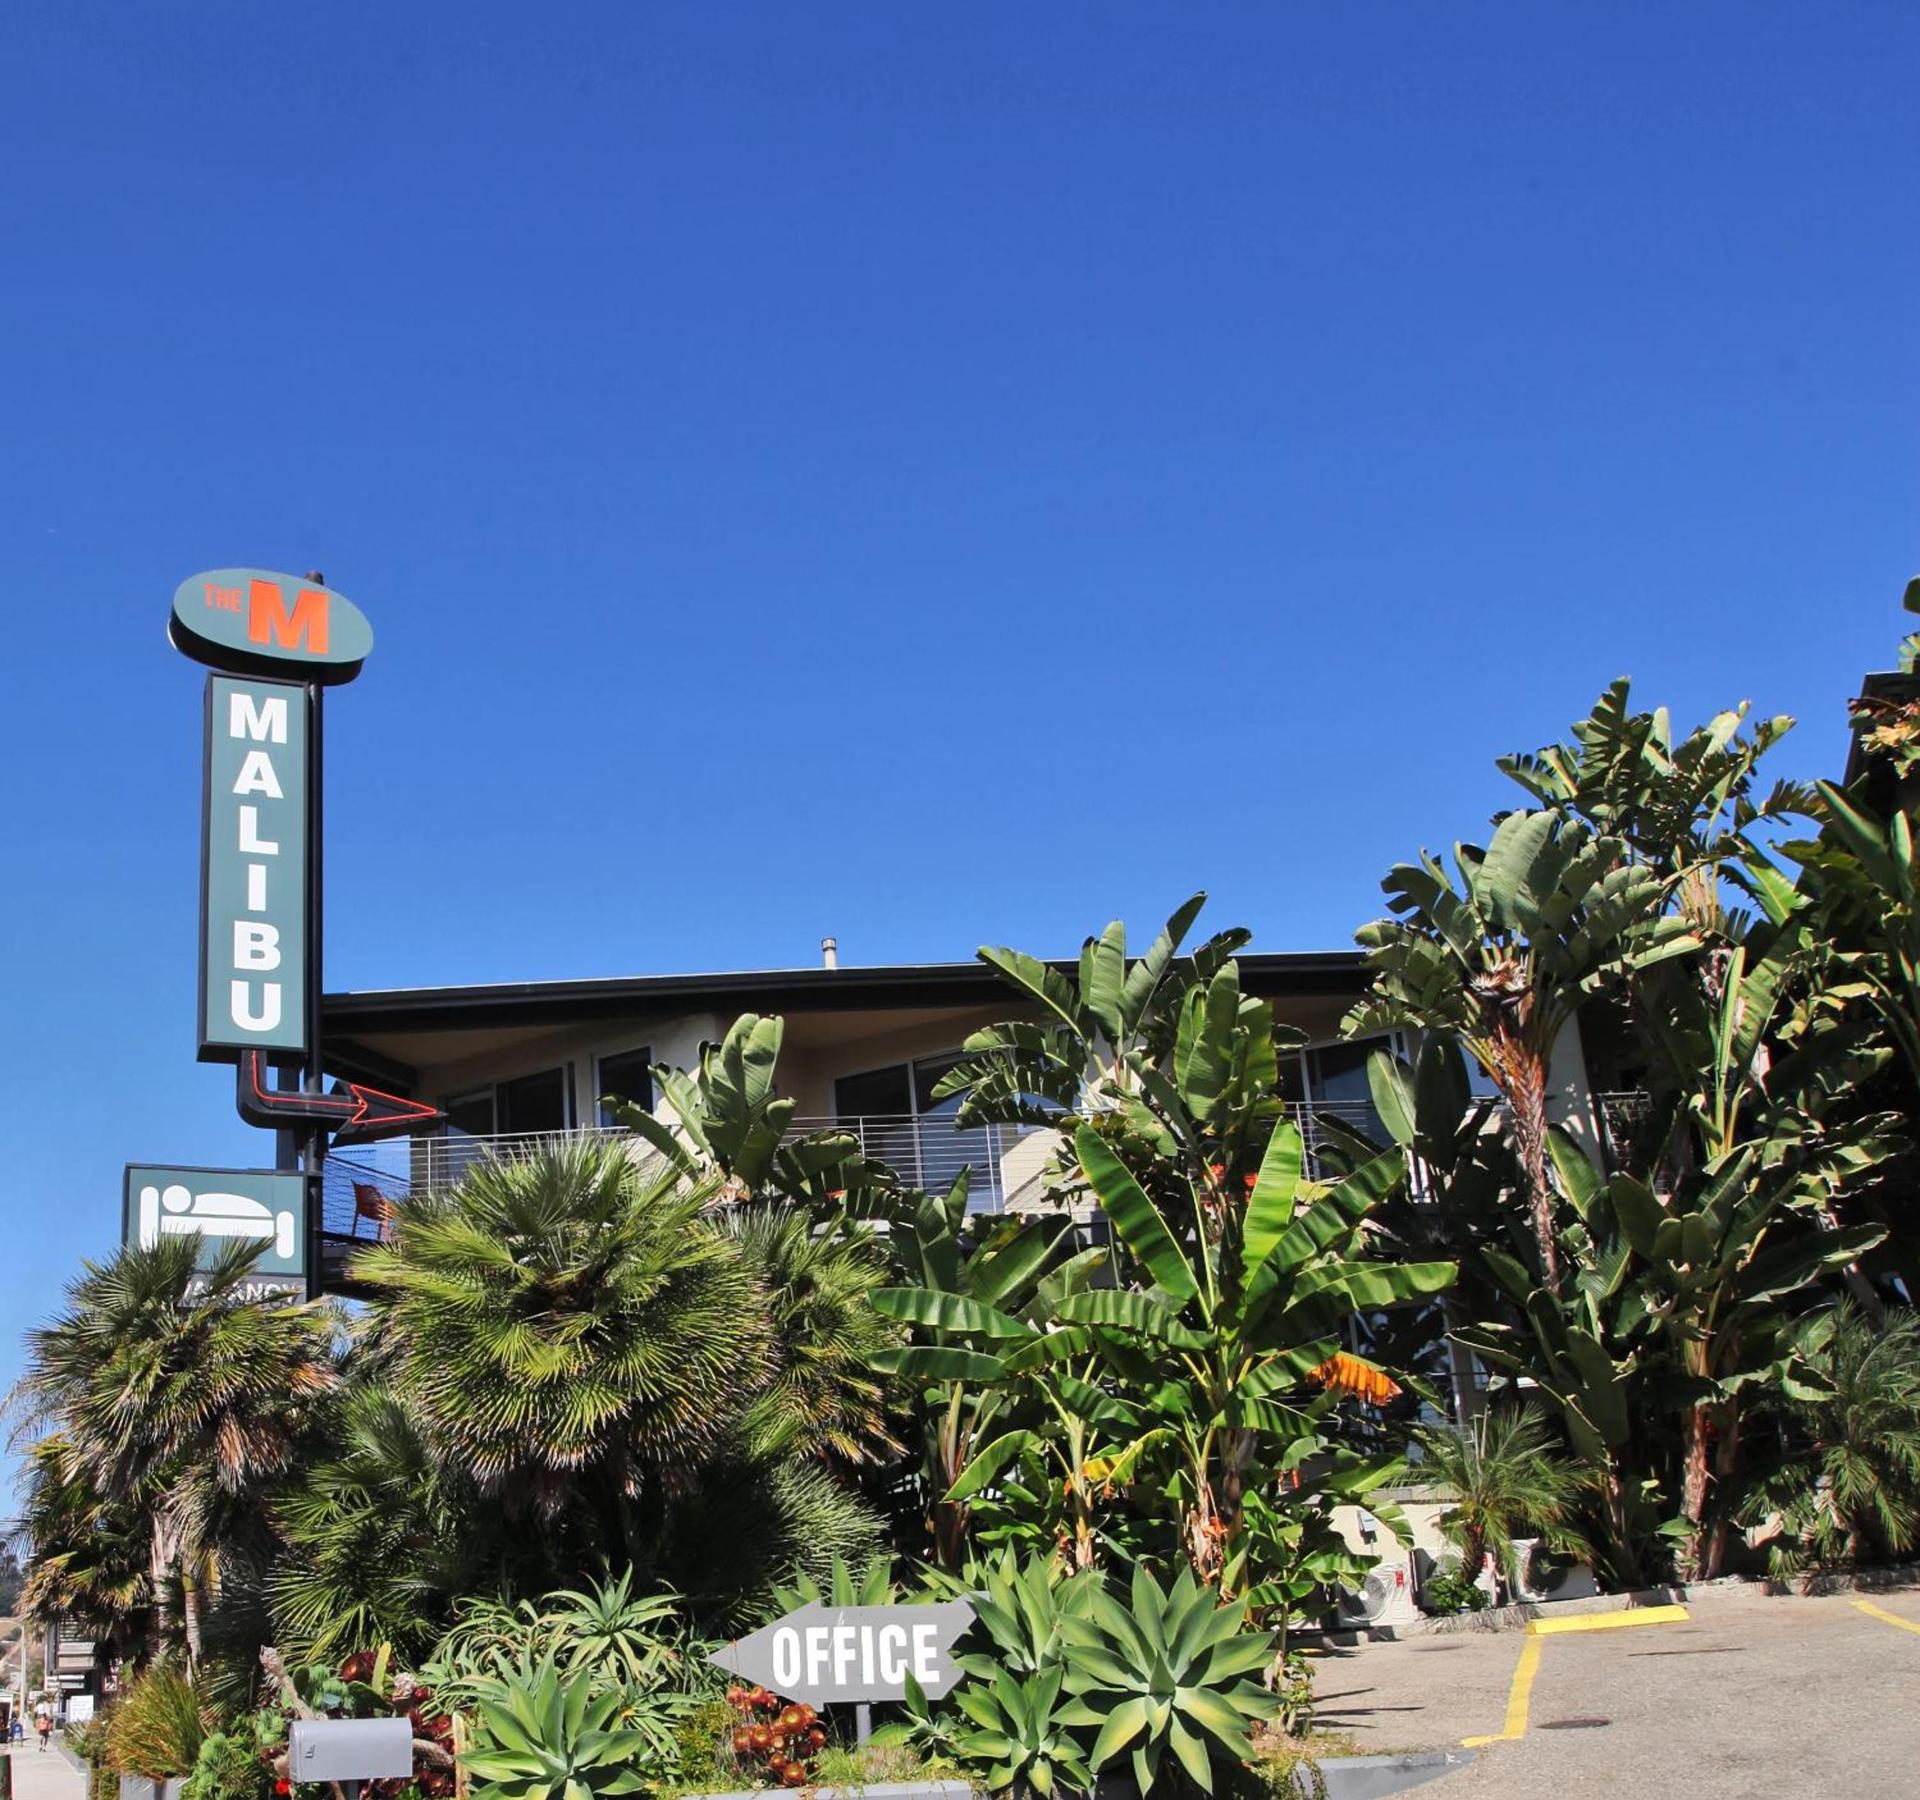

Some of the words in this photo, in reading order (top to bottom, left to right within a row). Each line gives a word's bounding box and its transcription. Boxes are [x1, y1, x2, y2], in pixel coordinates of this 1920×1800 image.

[203, 582, 244, 613] THE
[247, 578, 329, 656] M
[229, 692, 288, 1032] MALIBU
[772, 1623, 940, 1688] OFFICE
